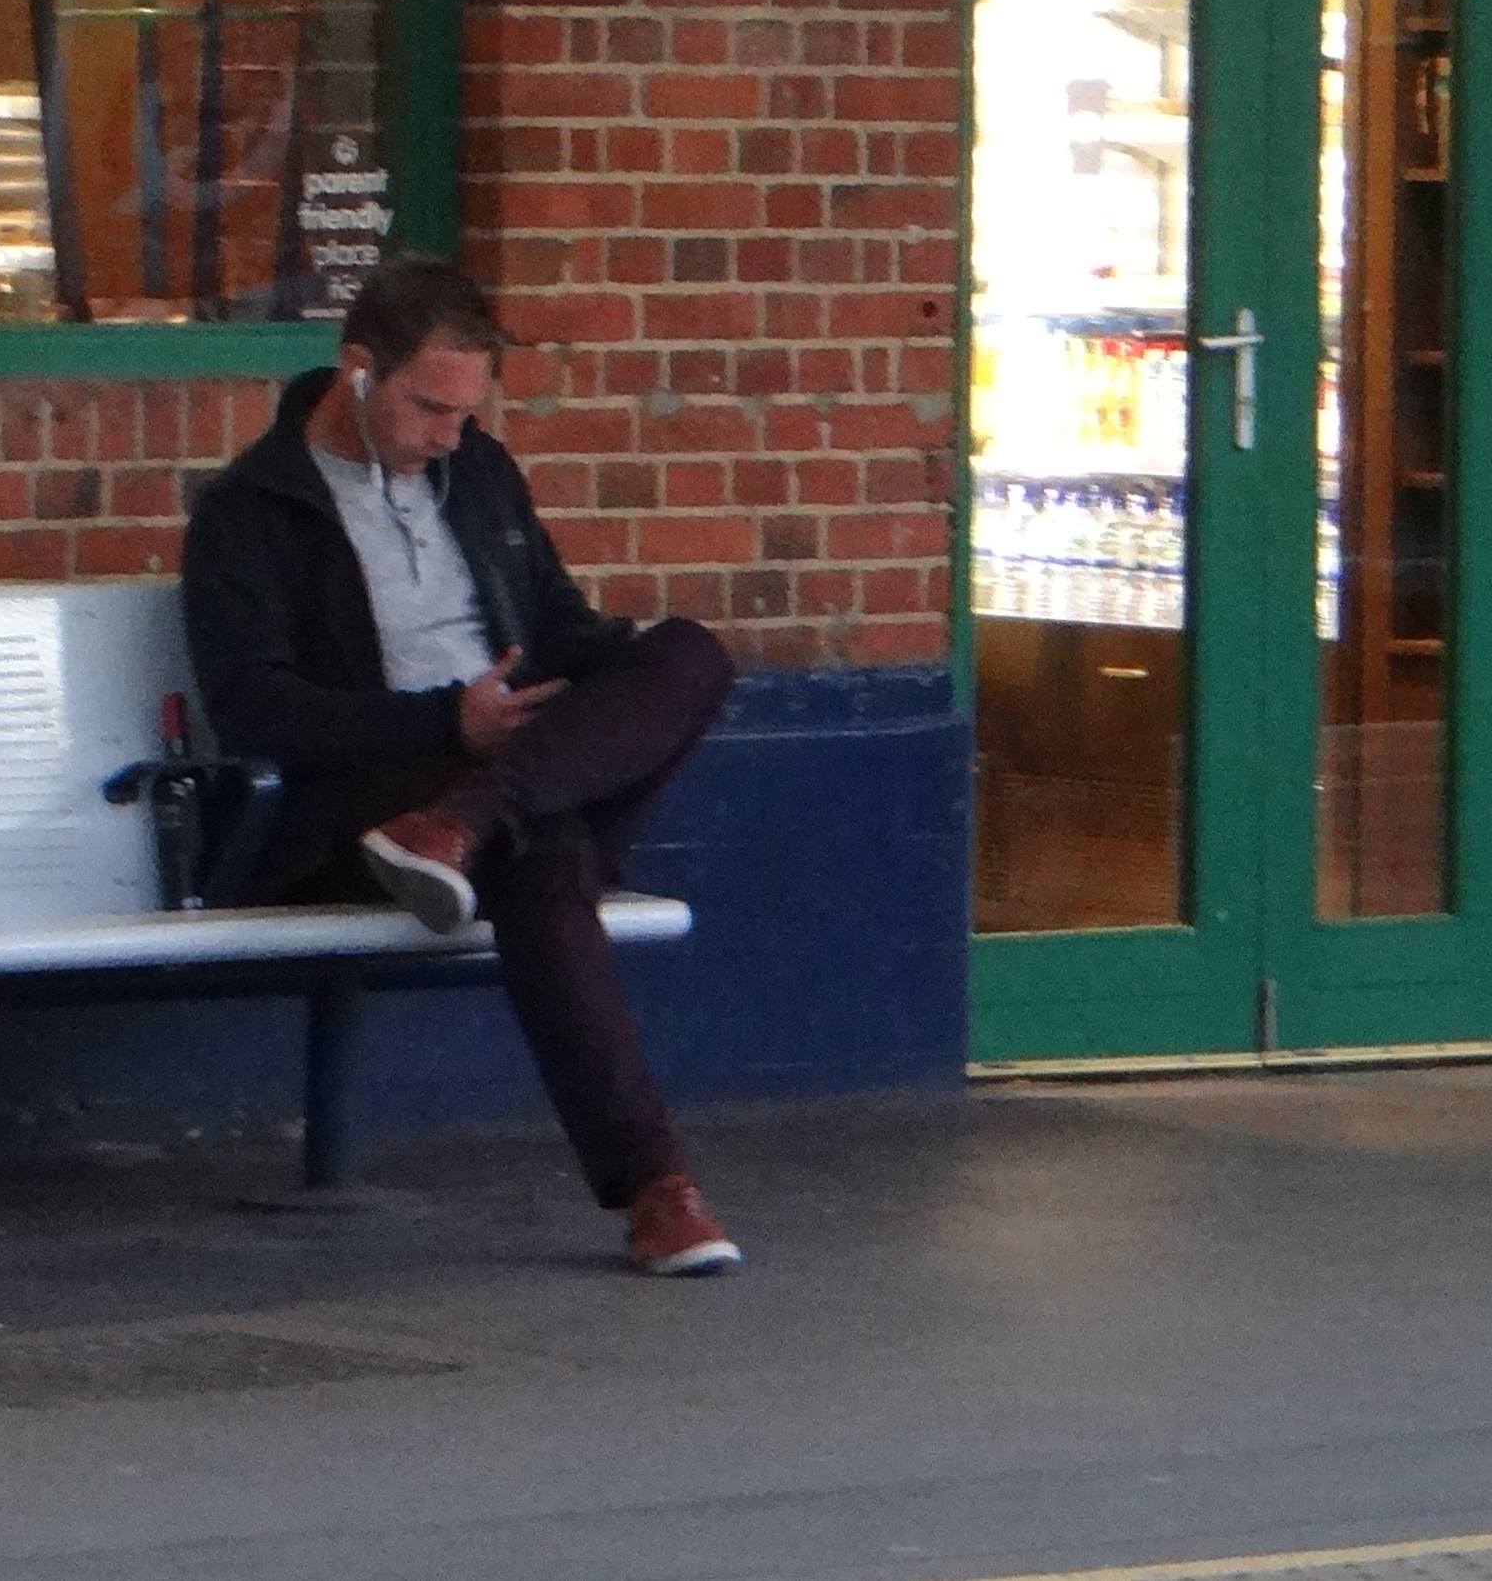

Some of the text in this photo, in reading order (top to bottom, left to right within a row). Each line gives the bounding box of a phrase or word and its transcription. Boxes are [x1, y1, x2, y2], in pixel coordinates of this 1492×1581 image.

[303, 169, 389, 201] parent
[296, 201, 395, 237] friendly
[309, 239, 381, 272] place
